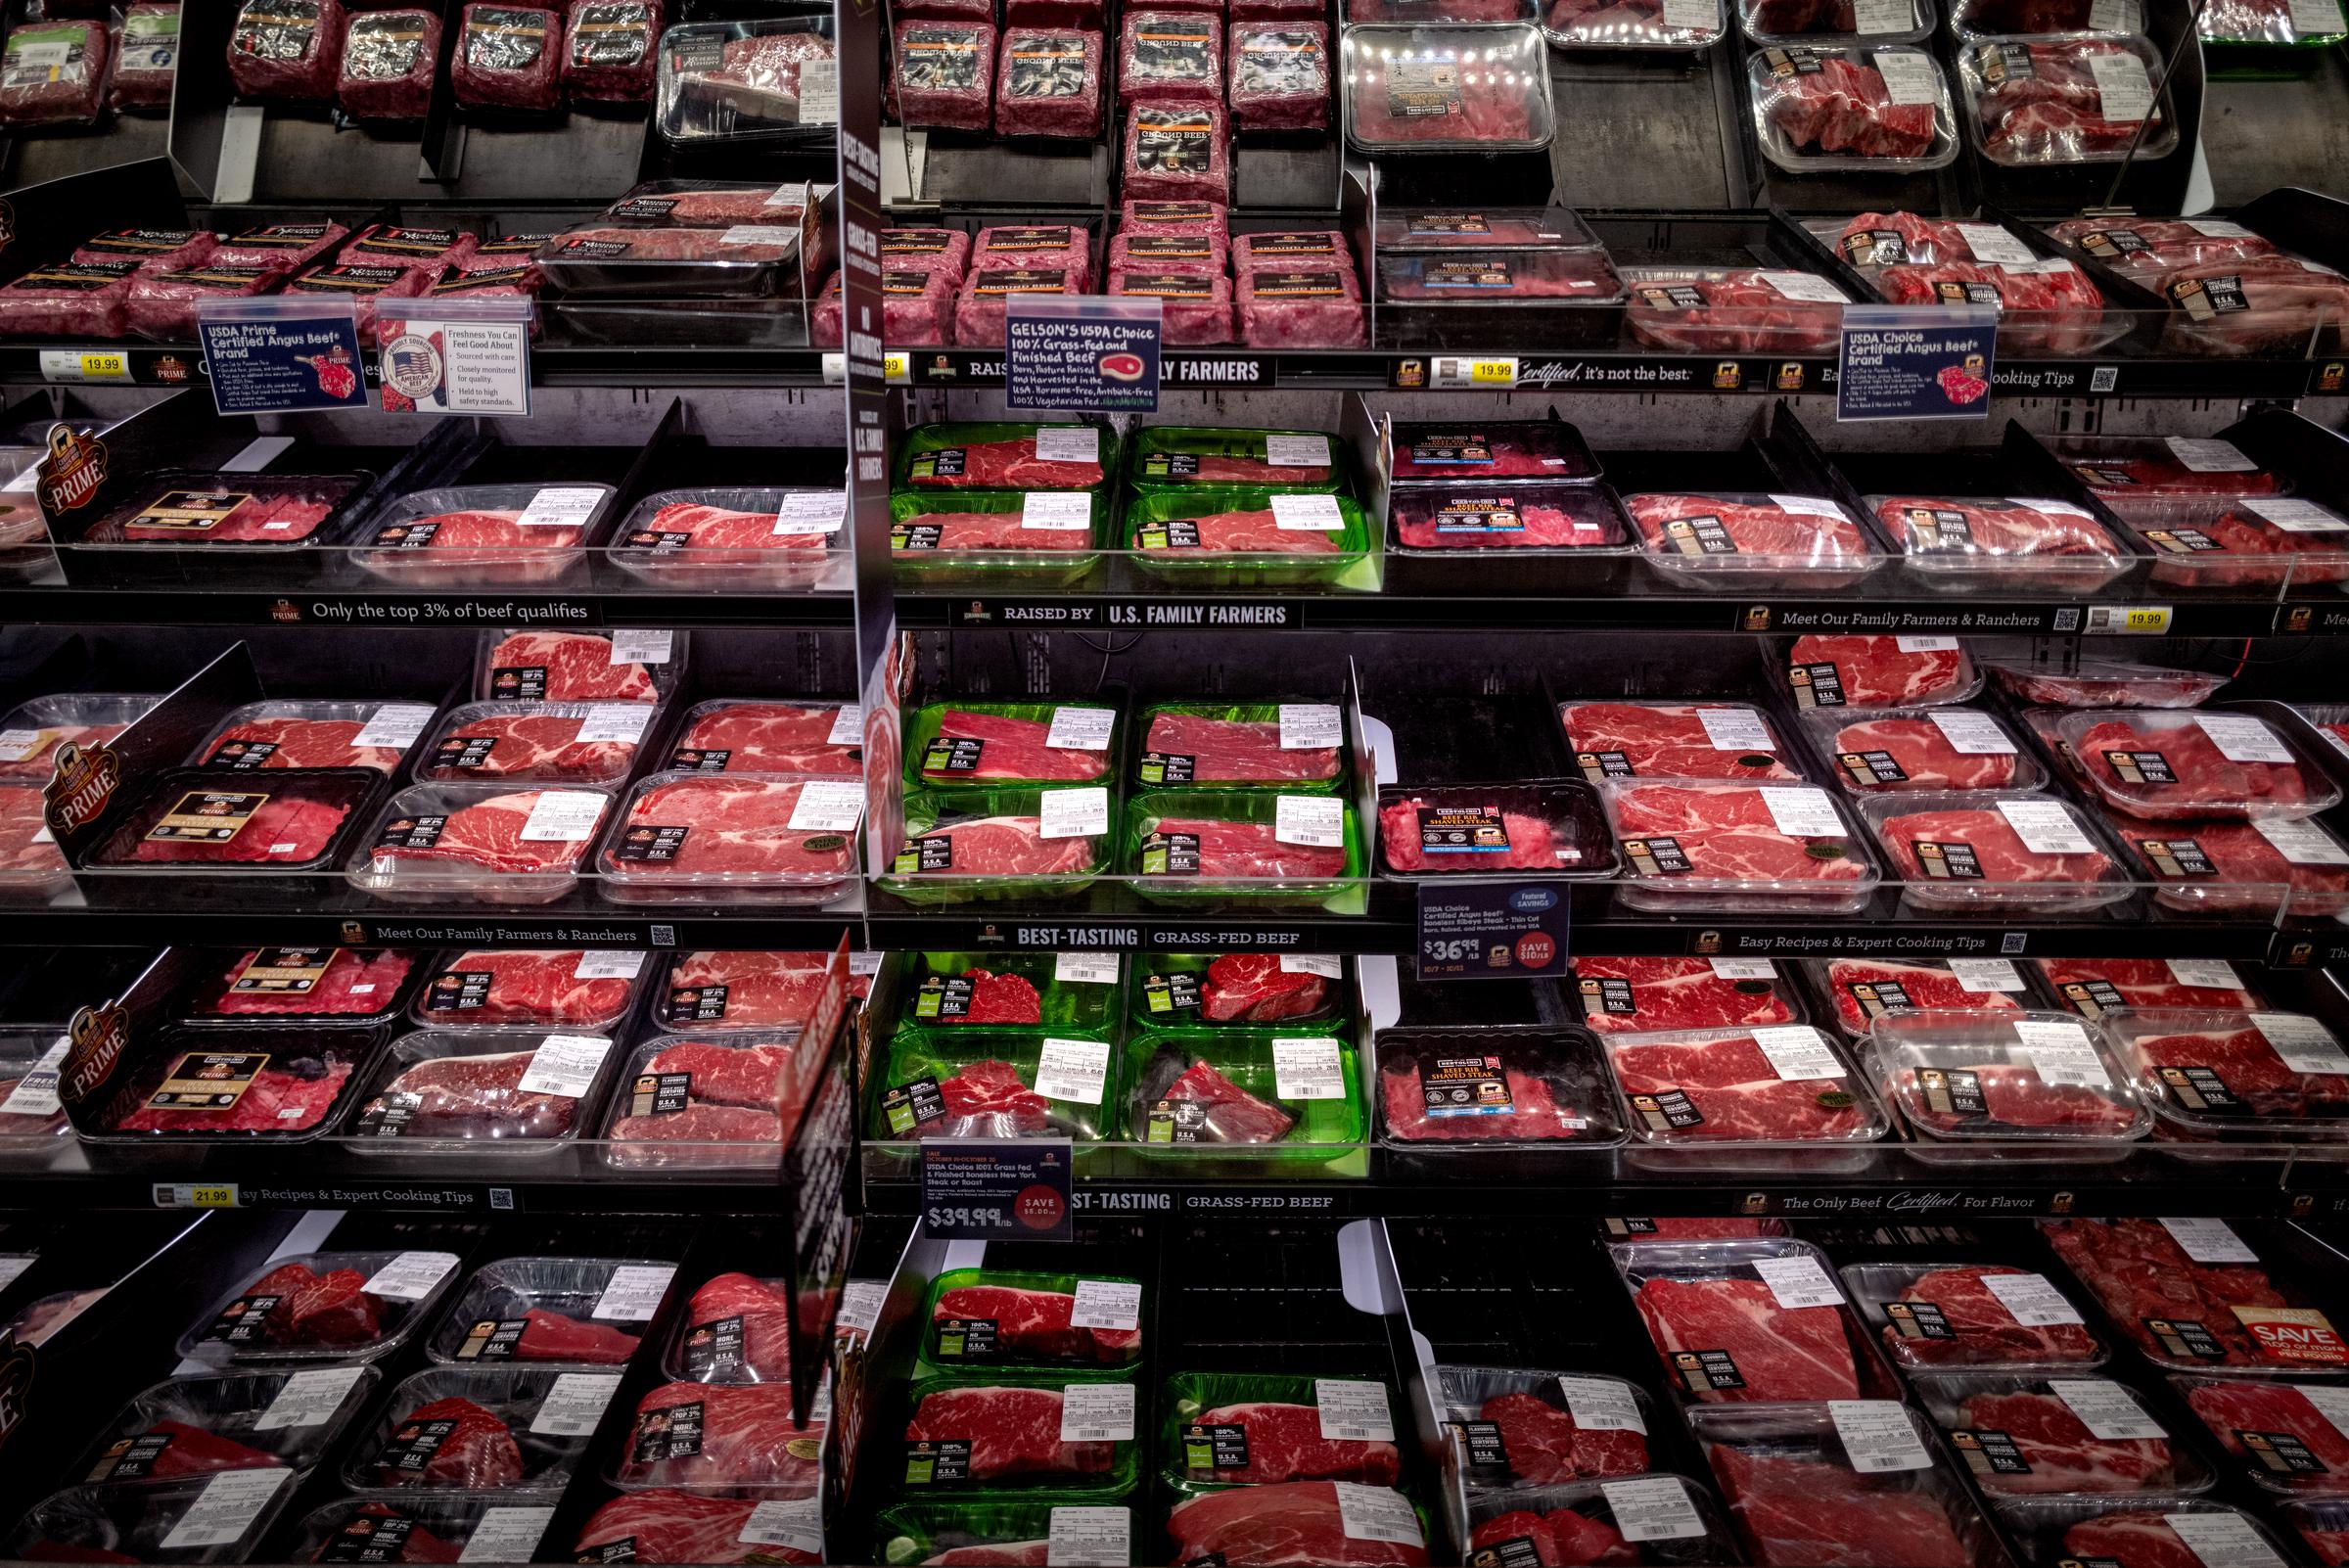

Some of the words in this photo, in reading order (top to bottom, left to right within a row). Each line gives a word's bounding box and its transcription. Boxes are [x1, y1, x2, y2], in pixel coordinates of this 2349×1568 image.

[207, 326, 239, 338] USDA
[242, 325, 277, 336] Prime
[448, 330, 488, 340] Freshness
[487, 331, 501, 340] You
[1011, 323, 1079, 337] GELSON'S
[1081, 325, 1111, 339] USDA
[1113, 326, 1155, 340] Choice
[210, 336, 264, 348] Certified
[267, 336, 304, 347] Angus
[1850, 333, 1879, 344] USDA
[1883, 332, 1924, 343] Choice
[453, 340, 468, 348] Feel
[470, 341, 488, 349] Good
[489, 341, 513, 349] About
[1012, 338, 1040, 350] 100%
[1043, 338, 1103, 351] Grass-Fed
[1105, 339, 1128, 351] and
[1849, 343, 1902, 354] Certified
[1905, 343, 1943, 355] Angus
[212, 347, 250, 359] Brand
[456, 351, 484, 360] Sourced
[484, 352, 500, 361] with
[1012, 351, 1062, 363] Finished
[1065, 351, 1096, 363] Beef
[87, 359, 119, 370] 19.99
[1848, 354, 1883, 366] Brand
[158, 369, 187, 379] PRIME
[457, 365, 481, 375] Closely
[482, 365, 516, 374] monitored
[1012, 364, 1035, 375] Born,
[1036, 364, 1066, 374] Pasture
[1067, 364, 1095, 374] Raised
[1179, 361, 1259, 381] FARMERS
[1480, 365, 1510, 376] 19.99
[1584, 365, 1604, 380] it's
[1606, 367, 1631, 380] not
[1633, 365, 1656, 380] the
[400, 374, 429, 383] AMERICAN
[458, 374, 469, 383] for
[1080, 376, 1088, 385] in
[1089, 376, 1103, 385] the
[2045, 371, 2075, 387] Tips
[484, 389, 498, 397] high
[459, 397, 480, 406] safety
[481, 397, 515, 406] standards.
[1013, 395, 1034, 405] 100%
[1036, 395, 1083, 407] Vegetarian
[52, 459, 104, 509] PRIME
[272, 611, 299, 620] PRIME
[313, 603, 353, 622] Only
[357, 603, 385, 618] the
[390, 604, 419, 622] top
[423, 603, 449, 618] 3%
[455, 602, 474, 618] of
[477, 602, 514, 618] beef
[517, 602, 587, 622] qualifies
[1004, 607, 1067, 620] RAISED
[1070, 608, 1094, 620] BY
[1109, 606, 1141, 623] U.S.
[1146, 606, 1204, 623] FAMILY
[1208, 606, 1286, 623] FARMERS
[1781, 613, 1818, 624] Meet
[1821, 613, 1848, 624] Our
[1851, 612, 1899, 627] Family
[1901, 614, 1958, 625] Farmers
[1960, 615, 1971, 626] &
[1974, 614, 2040, 626] Ranchers
[2130, 614, 2161, 624] 19.99
[62, 767, 115, 829] PRIME
[1458, 911, 1482, 920] Angus
[377, 928, 413, 939] Meet
[416, 928, 442, 939] Our
[446, 928, 492, 942] Family
[496, 929, 553, 940] Farmers
[557, 929, 568, 940] &
[571, 929, 636, 941] Ranchers
[1017, 928, 1137, 945] BEST-TASTING
[1153, 932, 1252, 944] GRASS-FED
[1255, 932, 1300, 944] BEEF
[1521, 943, 1549, 951] SAVE
[1738, 937, 1772, 949] Easy
[1774, 937, 1828, 948] Recipes
[1831, 938, 1842, 948] &
[1845, 938, 1892, 949] Expert
[1895, 937, 1952, 949] Cooking
[1955, 937, 1985, 949] Tips
[73, 1027, 125, 1096] PRIME
[197, 1191, 227, 1201] 21.99
[259, 1189, 315, 1202] Recipes
[318, 1189, 329, 1200] &
[333, 1189, 379, 1202] Expert
[382, 1189, 441, 1204] Cooking
[442, 1190, 474, 1204] Tips
[1185, 1196, 1283, 1208] GRASS-FED
[1287, 1196, 1332, 1208] BEEF
[1025, 1198, 1055, 1207] SAVE
[1783, 1198, 1809, 1209] The
[1813, 1198, 1847, 1211] Only
[1850, 1197, 1882, 1208] Beef
[1962, 1197, 1986, 1208] For
[1989, 1196, 2035, 1208] Flavor
[2253, 1325, 2336, 1344] SAVE
[2310, 1343, 2347, 1352] more
[2302, 1352, 2344, 1360] POUND
